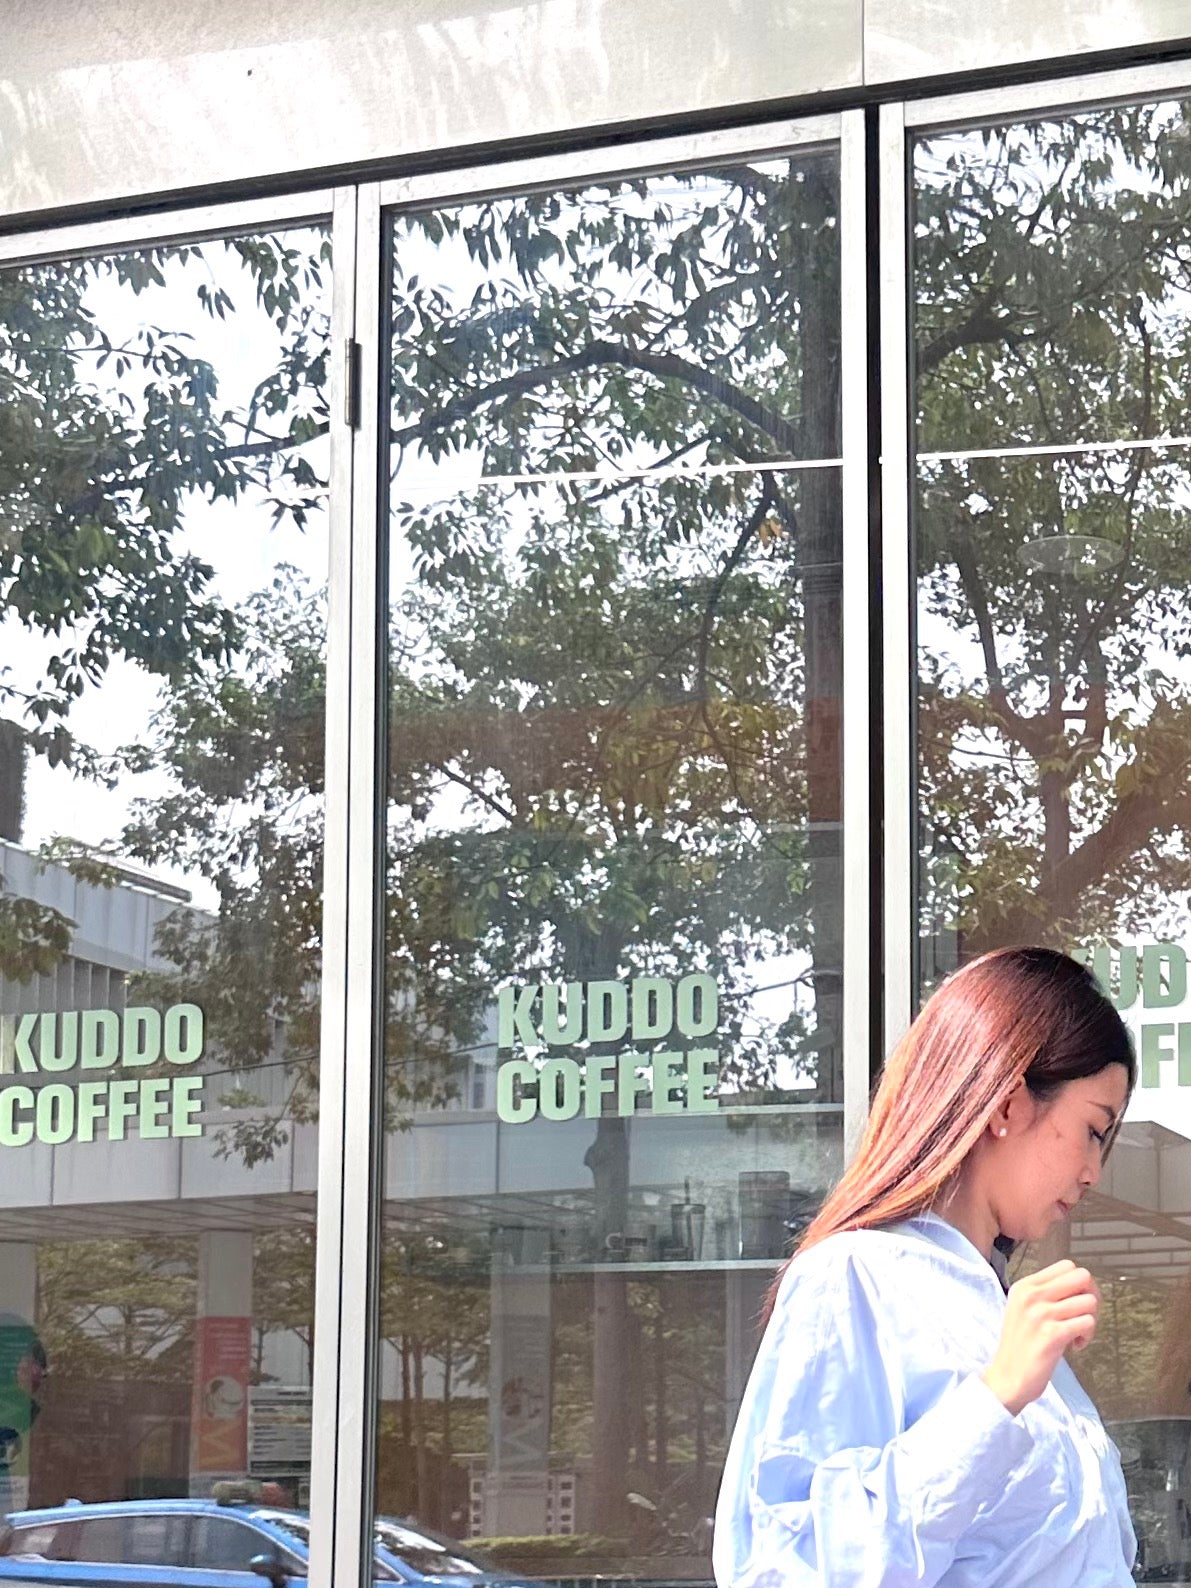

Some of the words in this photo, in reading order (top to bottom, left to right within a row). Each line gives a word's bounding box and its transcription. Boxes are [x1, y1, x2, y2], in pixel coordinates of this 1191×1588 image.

[0, 1003, 203, 1074] KUDDO
[499, 973, 718, 1048] KUDDO
[0, 1076, 203, 1146] COFFEE
[497, 1049, 719, 1123] COFFEE
